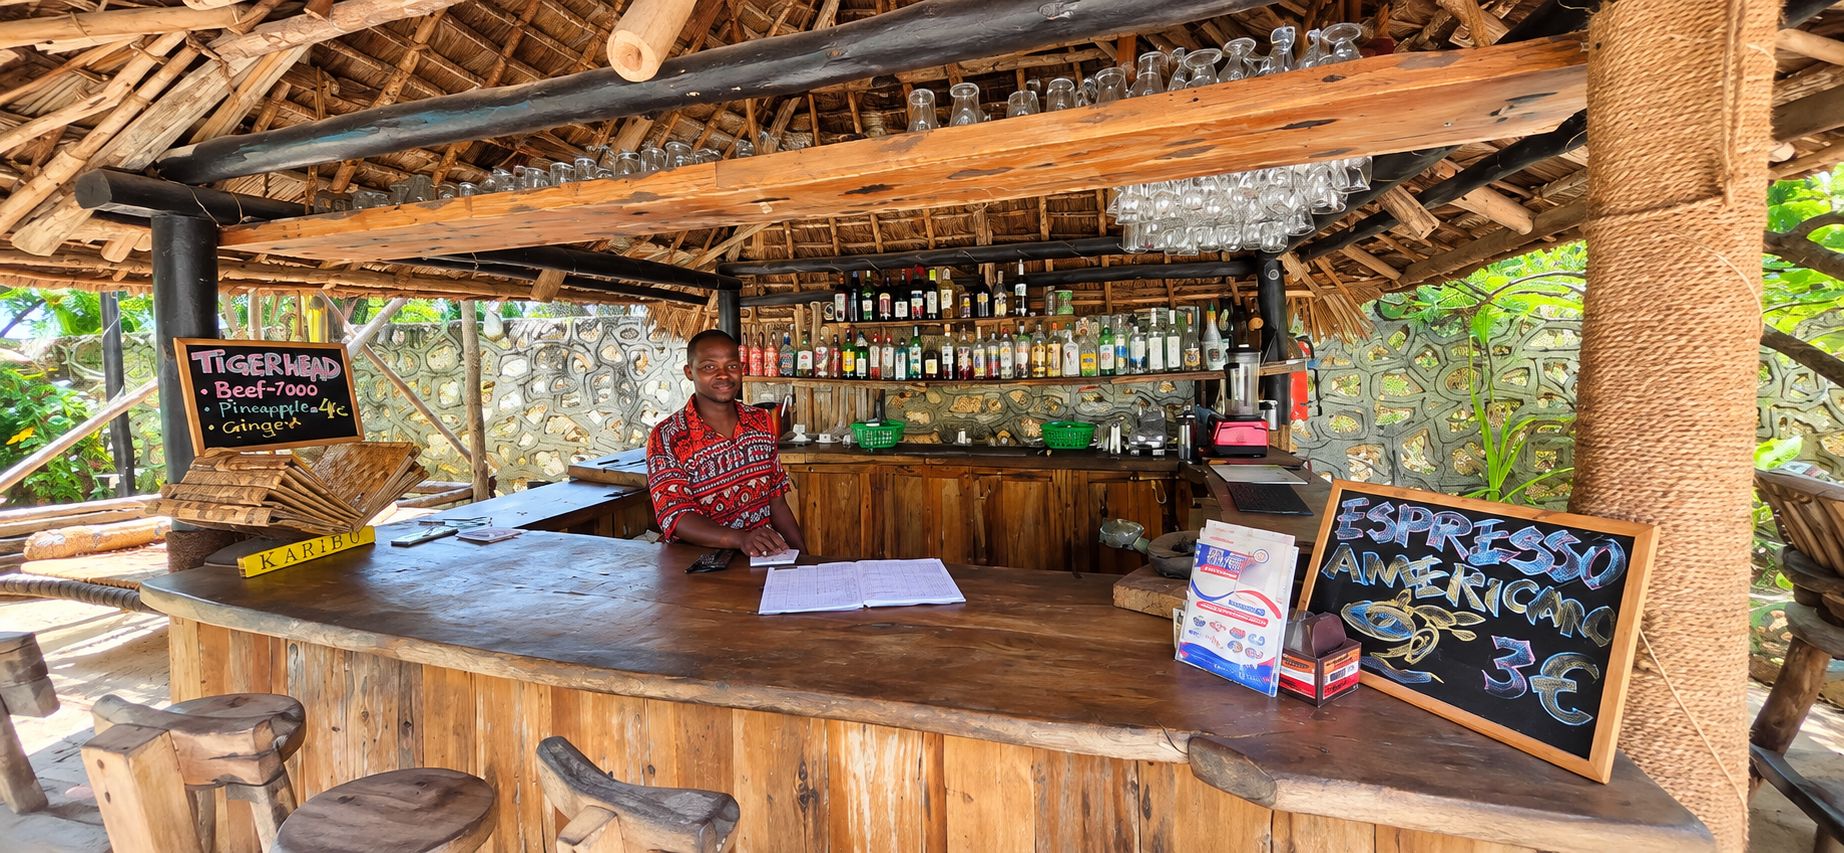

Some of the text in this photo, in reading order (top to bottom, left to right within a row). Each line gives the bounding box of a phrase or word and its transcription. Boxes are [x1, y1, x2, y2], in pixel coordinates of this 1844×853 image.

[214, 380, 318, 399] Beef-7000
[259, 531, 361, 570] KARIBU
[1335, 497, 1627, 590] ESPRESSO
[1321, 543, 1615, 648] AMERICANO
